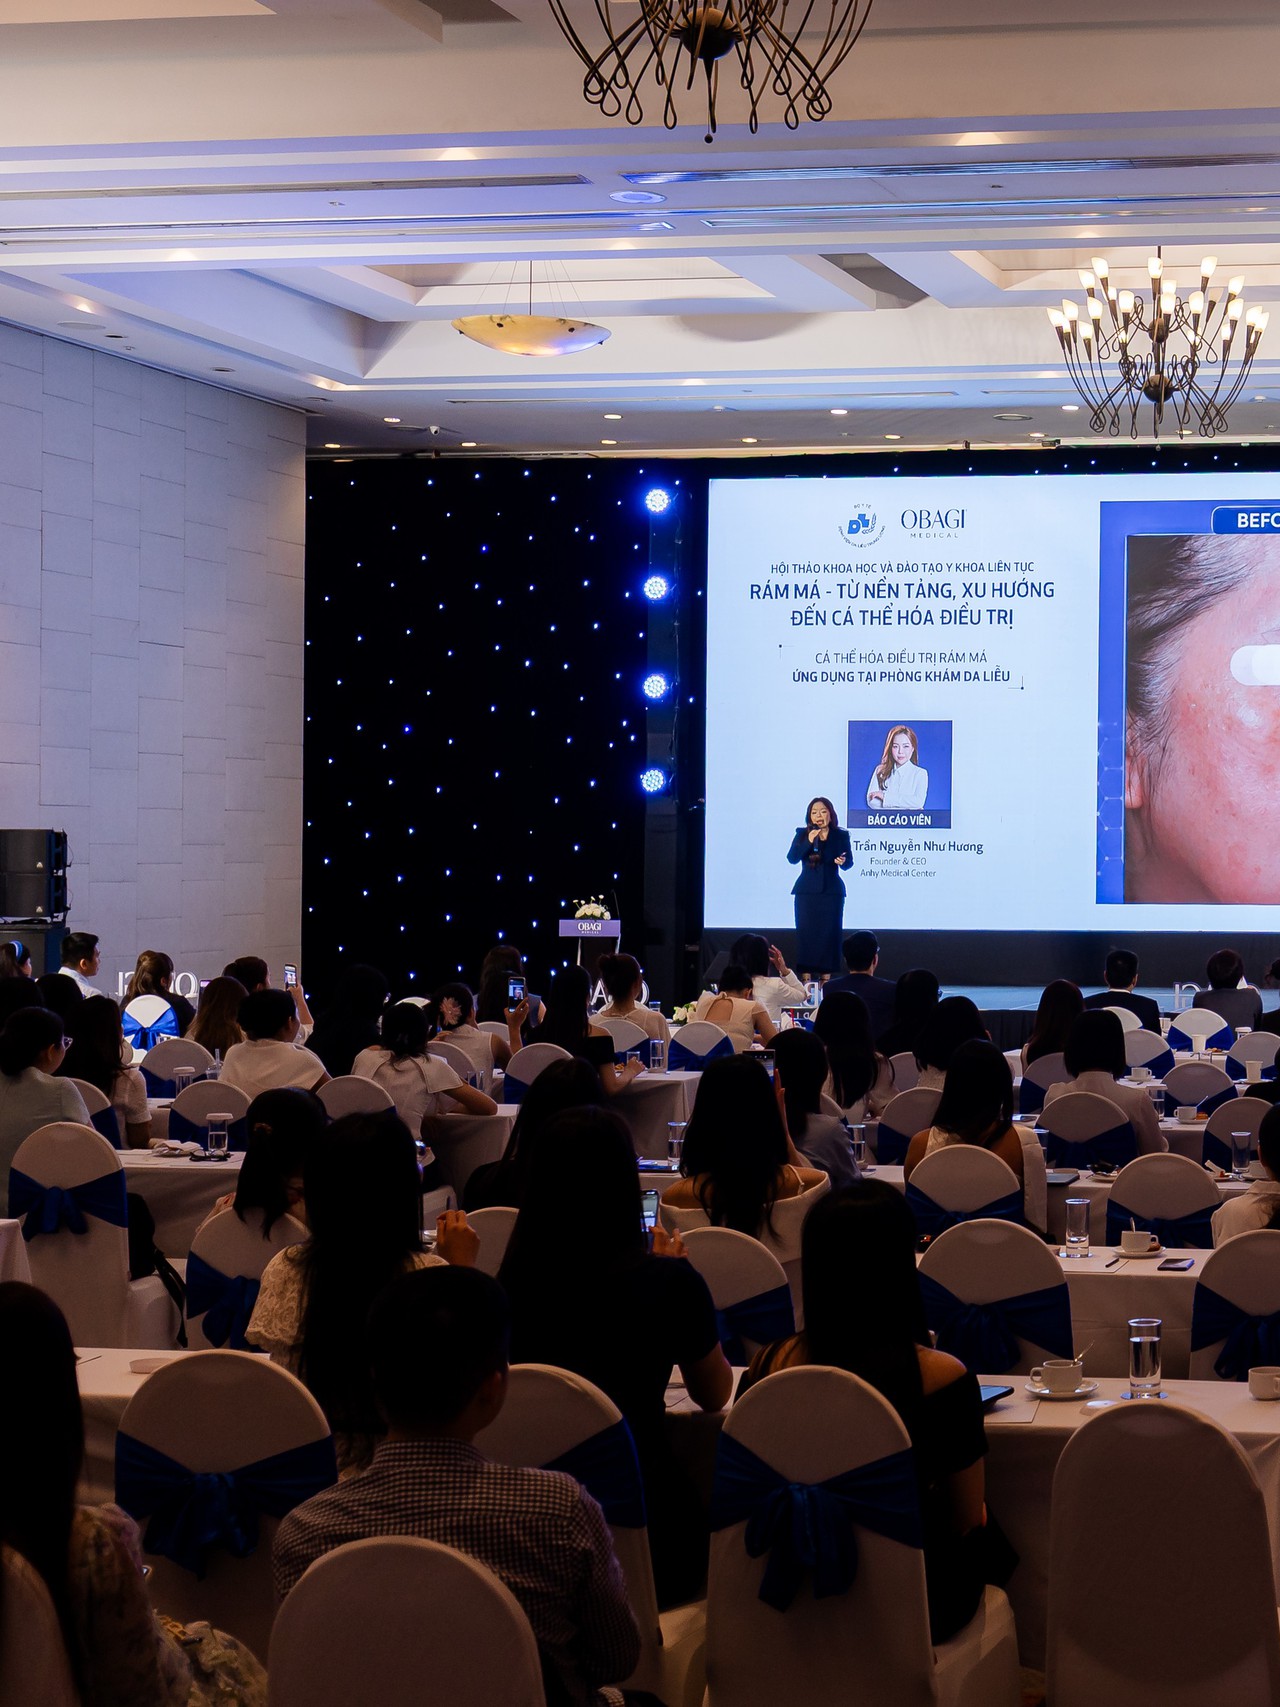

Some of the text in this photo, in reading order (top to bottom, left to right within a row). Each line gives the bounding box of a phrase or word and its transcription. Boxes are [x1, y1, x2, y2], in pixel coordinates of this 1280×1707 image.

[901, 508, 965, 530] OBAGI
[771, 561, 789, 576] HỘI
[823, 563, 853, 574] KHOA
[856, 563, 877, 576] HỌC
[880, 561, 893, 573] VÀ
[896, 560, 919, 573] ĐÀO
[921, 562, 943, 576] TẠO
[946, 563, 953, 573] Y
[955, 562, 985, 573] KHOA
[988, 560, 1011, 573] LIÊN
[1014, 562, 1034, 575] TỤC
[750, 579, 789, 600] RÁM
[794, 579, 821, 600] MÁ
[836, 579, 860, 599] TỪ
[864, 576, 899, 599] NỀN
[904, 578, 957, 601] TẢNG,
[962, 582, 986, 599] XU
[992, 577, 1055, 599] HƯỚNG
[790, 602, 1013, 630] ĐẾN CÁ THỂ HÓA ĐIỀU TRỊ
[815, 649, 830, 664] CÁ
[860, 649, 884, 664] HÓA
[918, 653, 937, 667] TRỊ
[940, 649, 966, 663] RÁM
[969, 649, 987, 663] MÁ
[792, 664, 1010, 685] ỨNG DỤNG TẠI PHÒNG KHÁM DA LIỄU
[867, 813, 931, 826] BÁO CÁO VIÊN
[853, 838, 984, 855] Trần Nguyễn Như Hương
[870, 857, 927, 866] Founder & CEO
[860, 868, 936, 879] Anhy Medical Center
[577, 922, 602, 931] OBAGI
